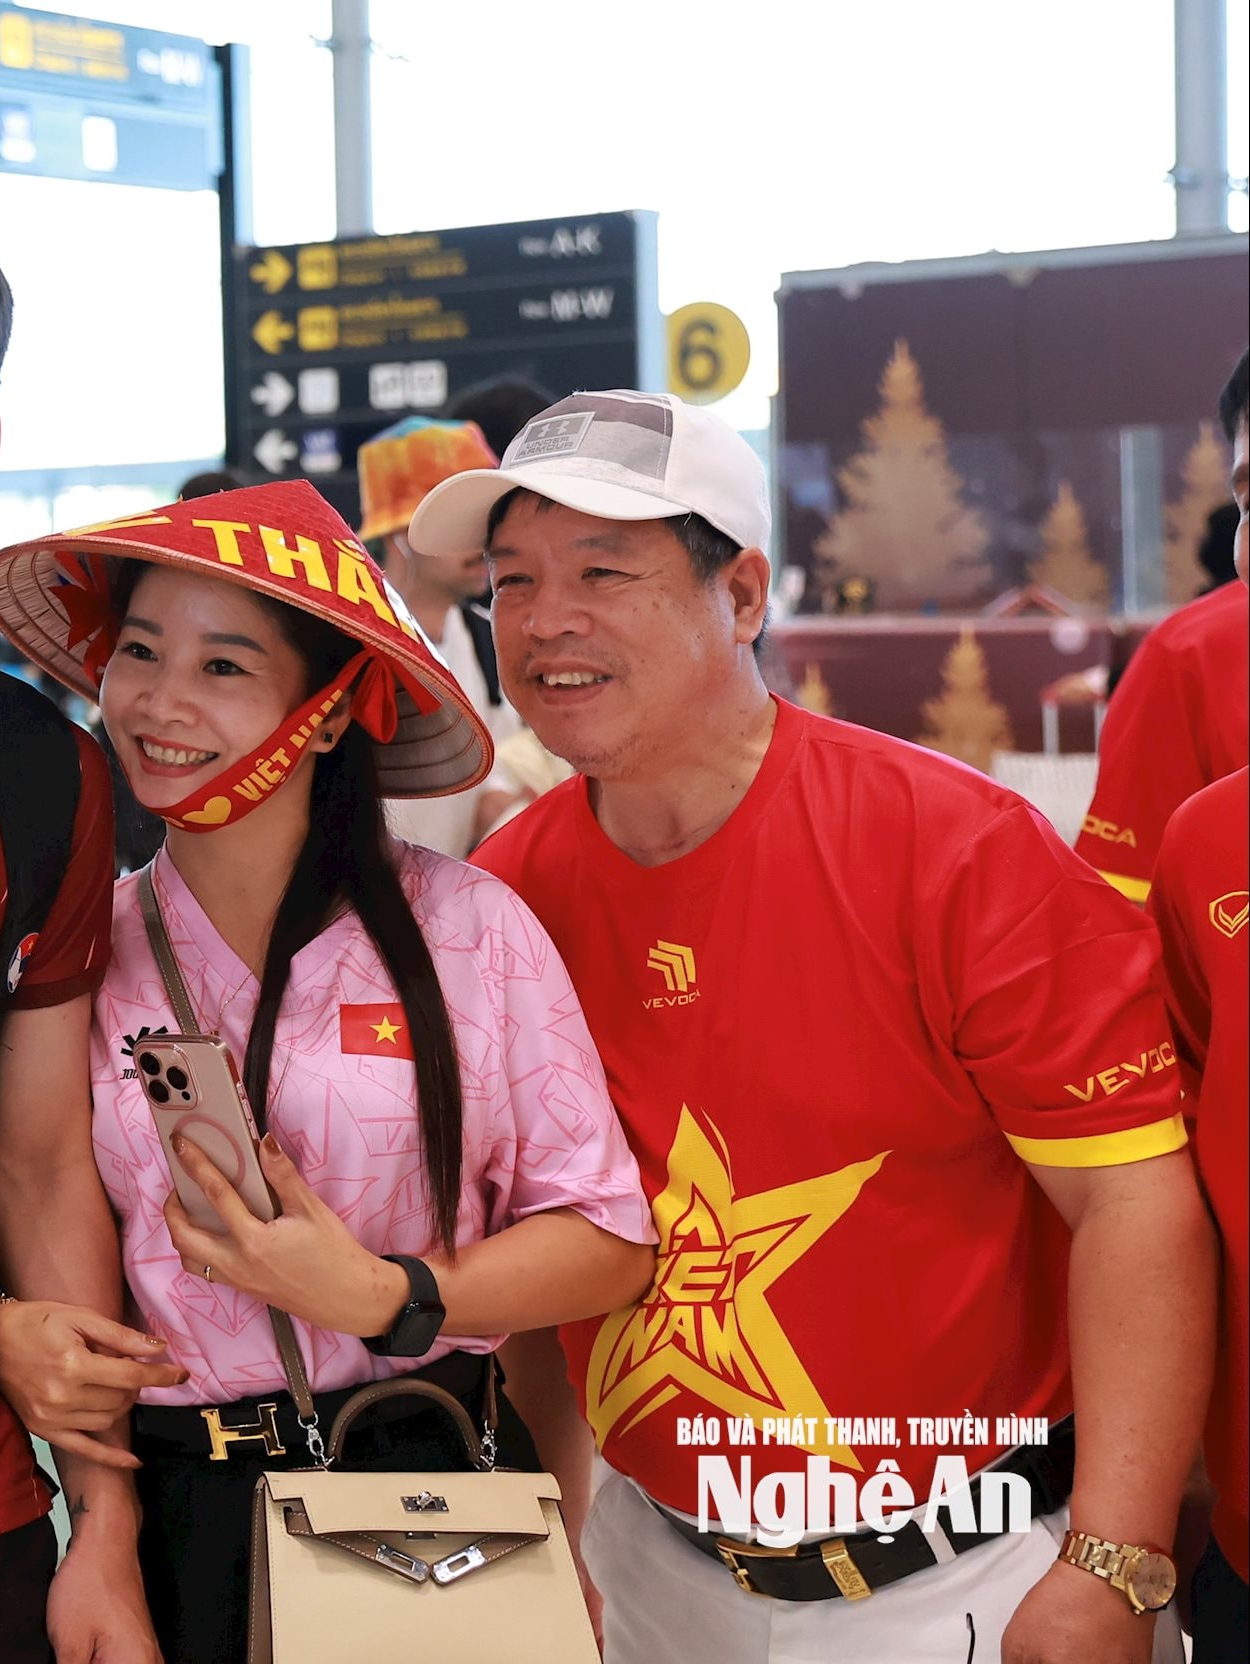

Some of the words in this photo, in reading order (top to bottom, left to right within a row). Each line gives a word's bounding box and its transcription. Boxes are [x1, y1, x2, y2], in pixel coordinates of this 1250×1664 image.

[678, 319, 724, 391] 6
[518, 441, 574, 457] ARMOUR
[527, 436, 570, 449] UNDER
[232, 747, 291, 801] VIỆT
[1081, 815, 1137, 849] OCA
[1063, 1042, 1176, 1102] VEVOC
